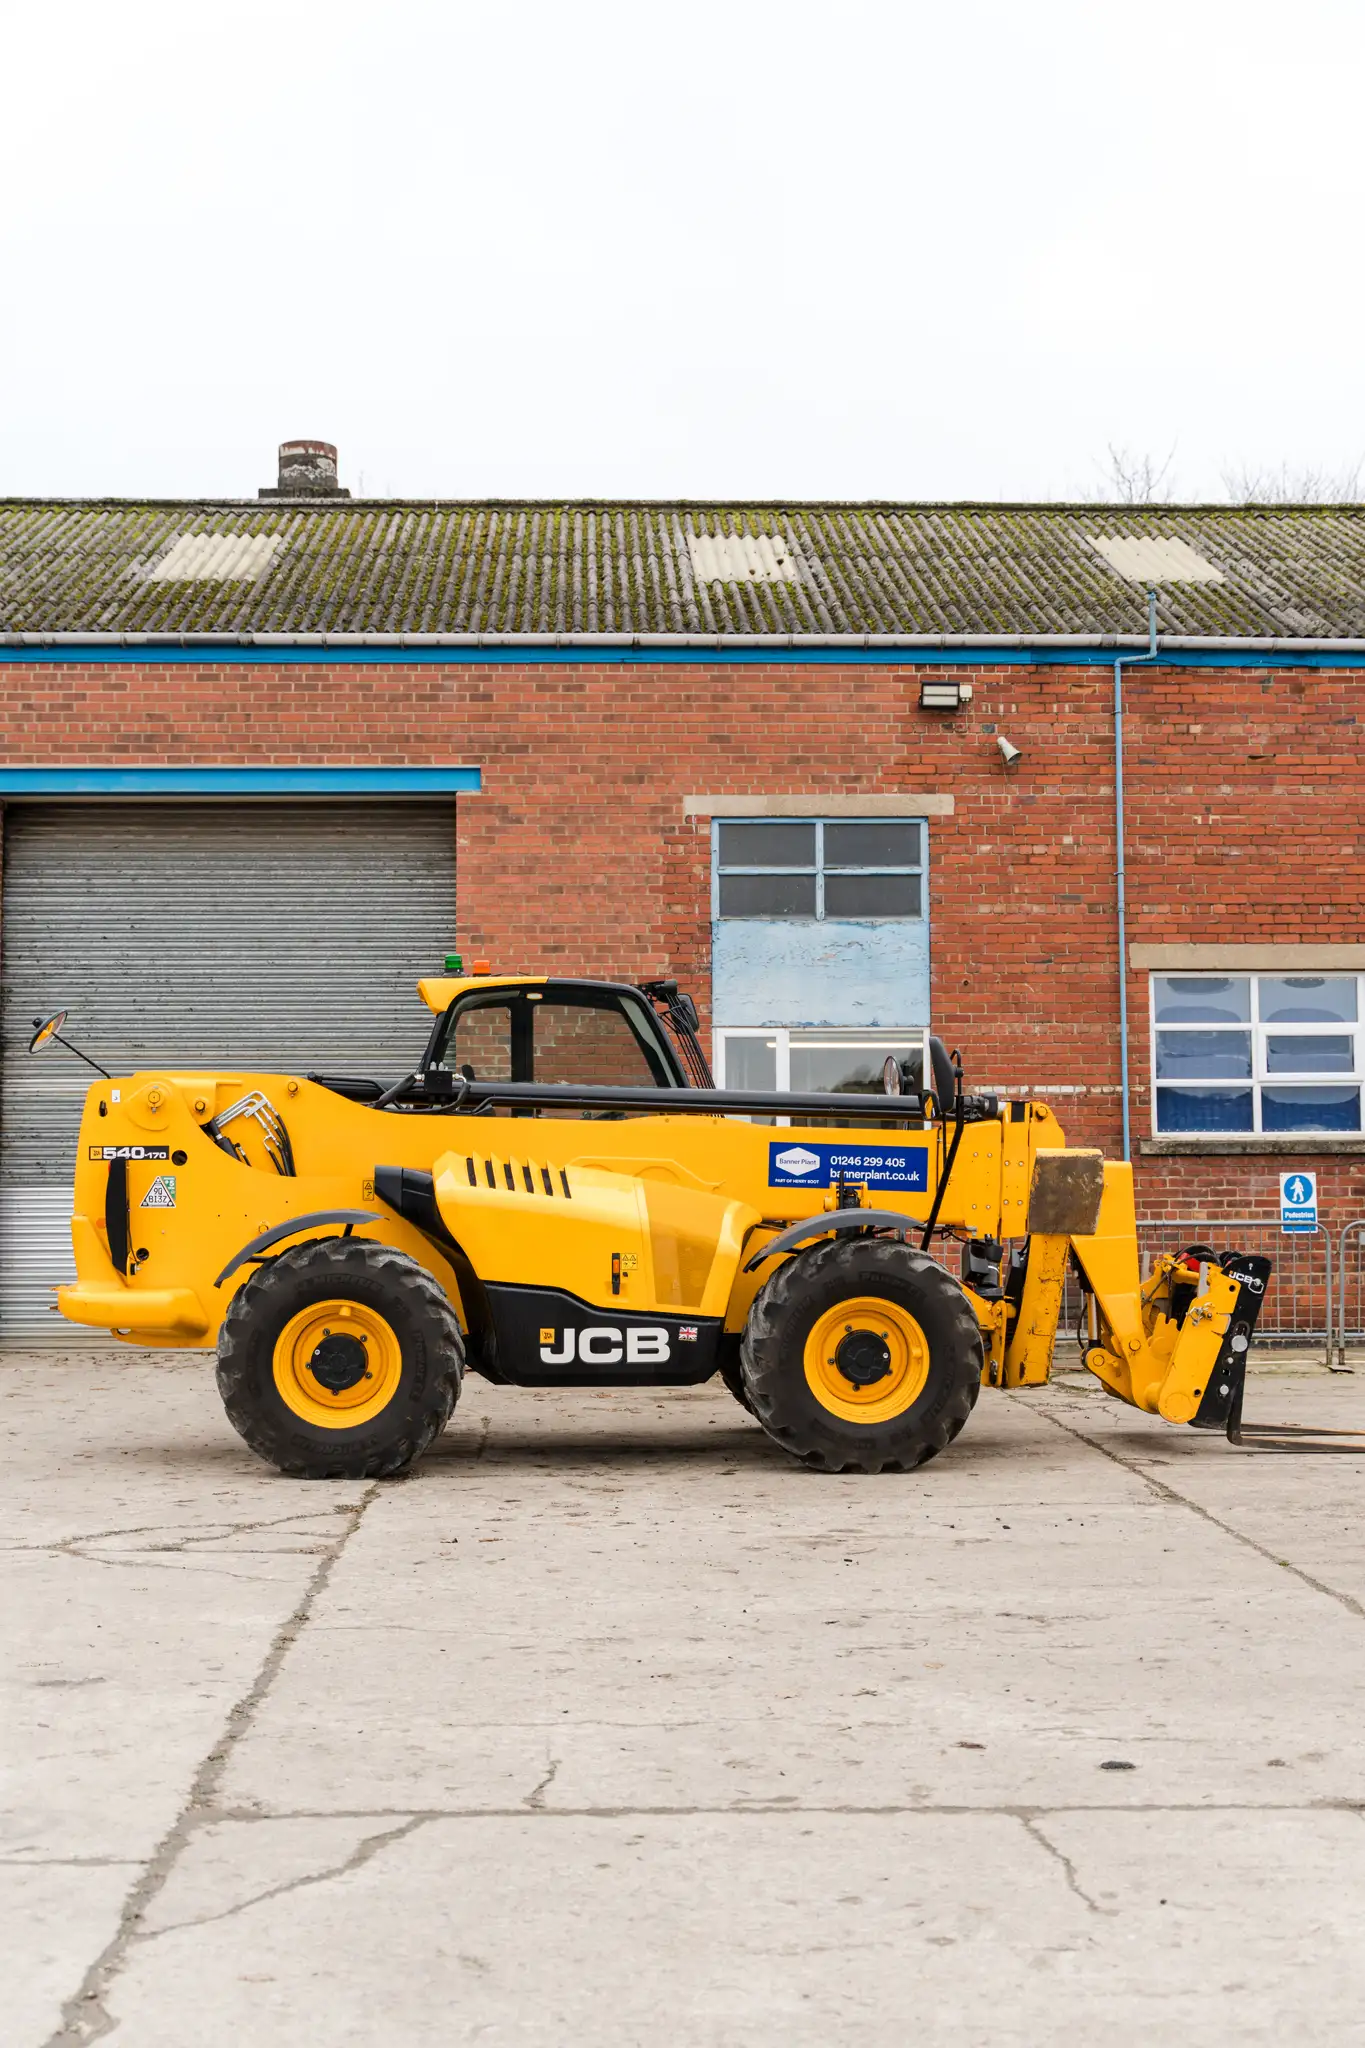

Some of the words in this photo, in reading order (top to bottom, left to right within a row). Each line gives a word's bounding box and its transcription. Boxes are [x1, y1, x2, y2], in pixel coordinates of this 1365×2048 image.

[779, 1157, 800, 1165] Banner
[801, 1158, 817, 1166] Plant
[830, 1155, 861, 1166] 01246
[863, 1157, 883, 1167] 299
[885, 1157, 906, 1168] 405
[830, 1168, 920, 1181] bannerplant.co.uk
[1229, 1271, 1253, 1284] JCB
[540, 1327, 671, 1365] JCB
